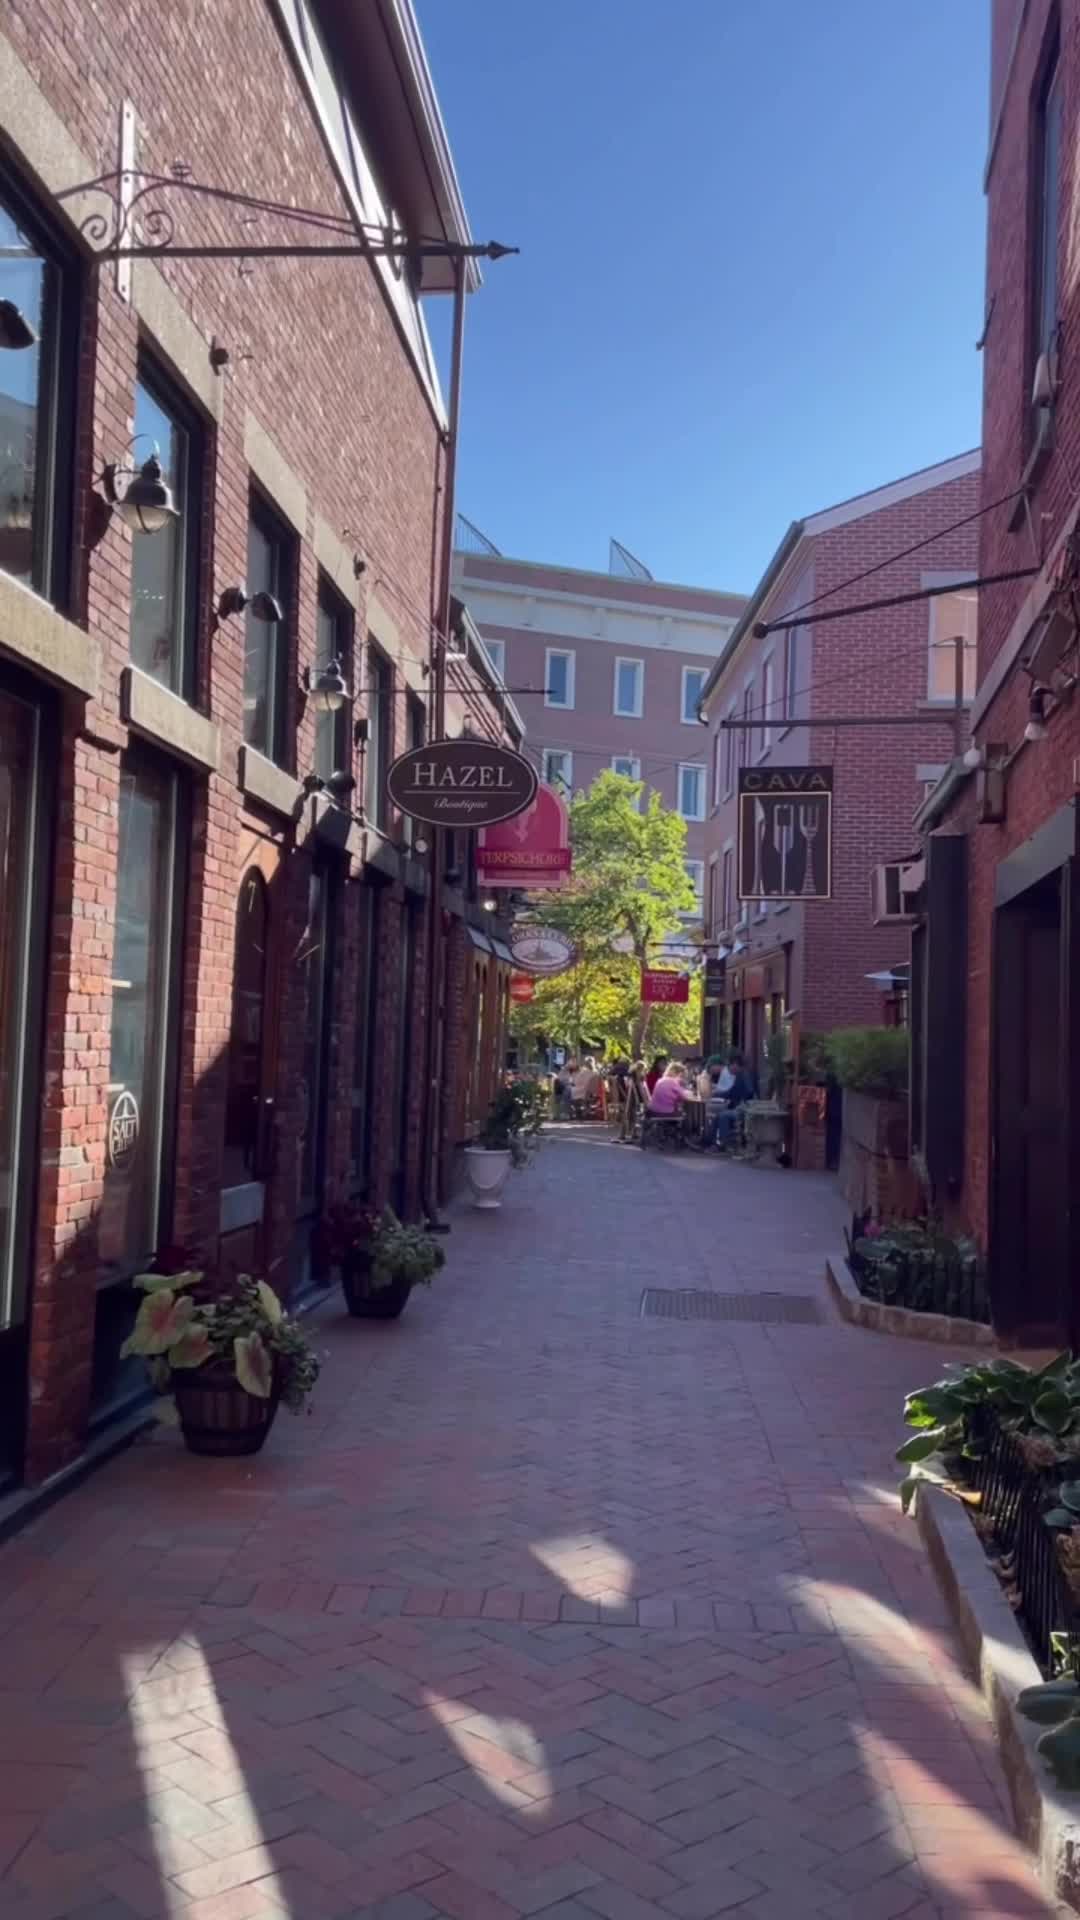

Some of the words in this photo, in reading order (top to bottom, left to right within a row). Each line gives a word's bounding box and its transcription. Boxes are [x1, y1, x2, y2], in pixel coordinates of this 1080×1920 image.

[412, 762, 513, 787] HAZEL
[744, 773, 828, 790] CAVA
[434, 798, 488, 812] Boutique
